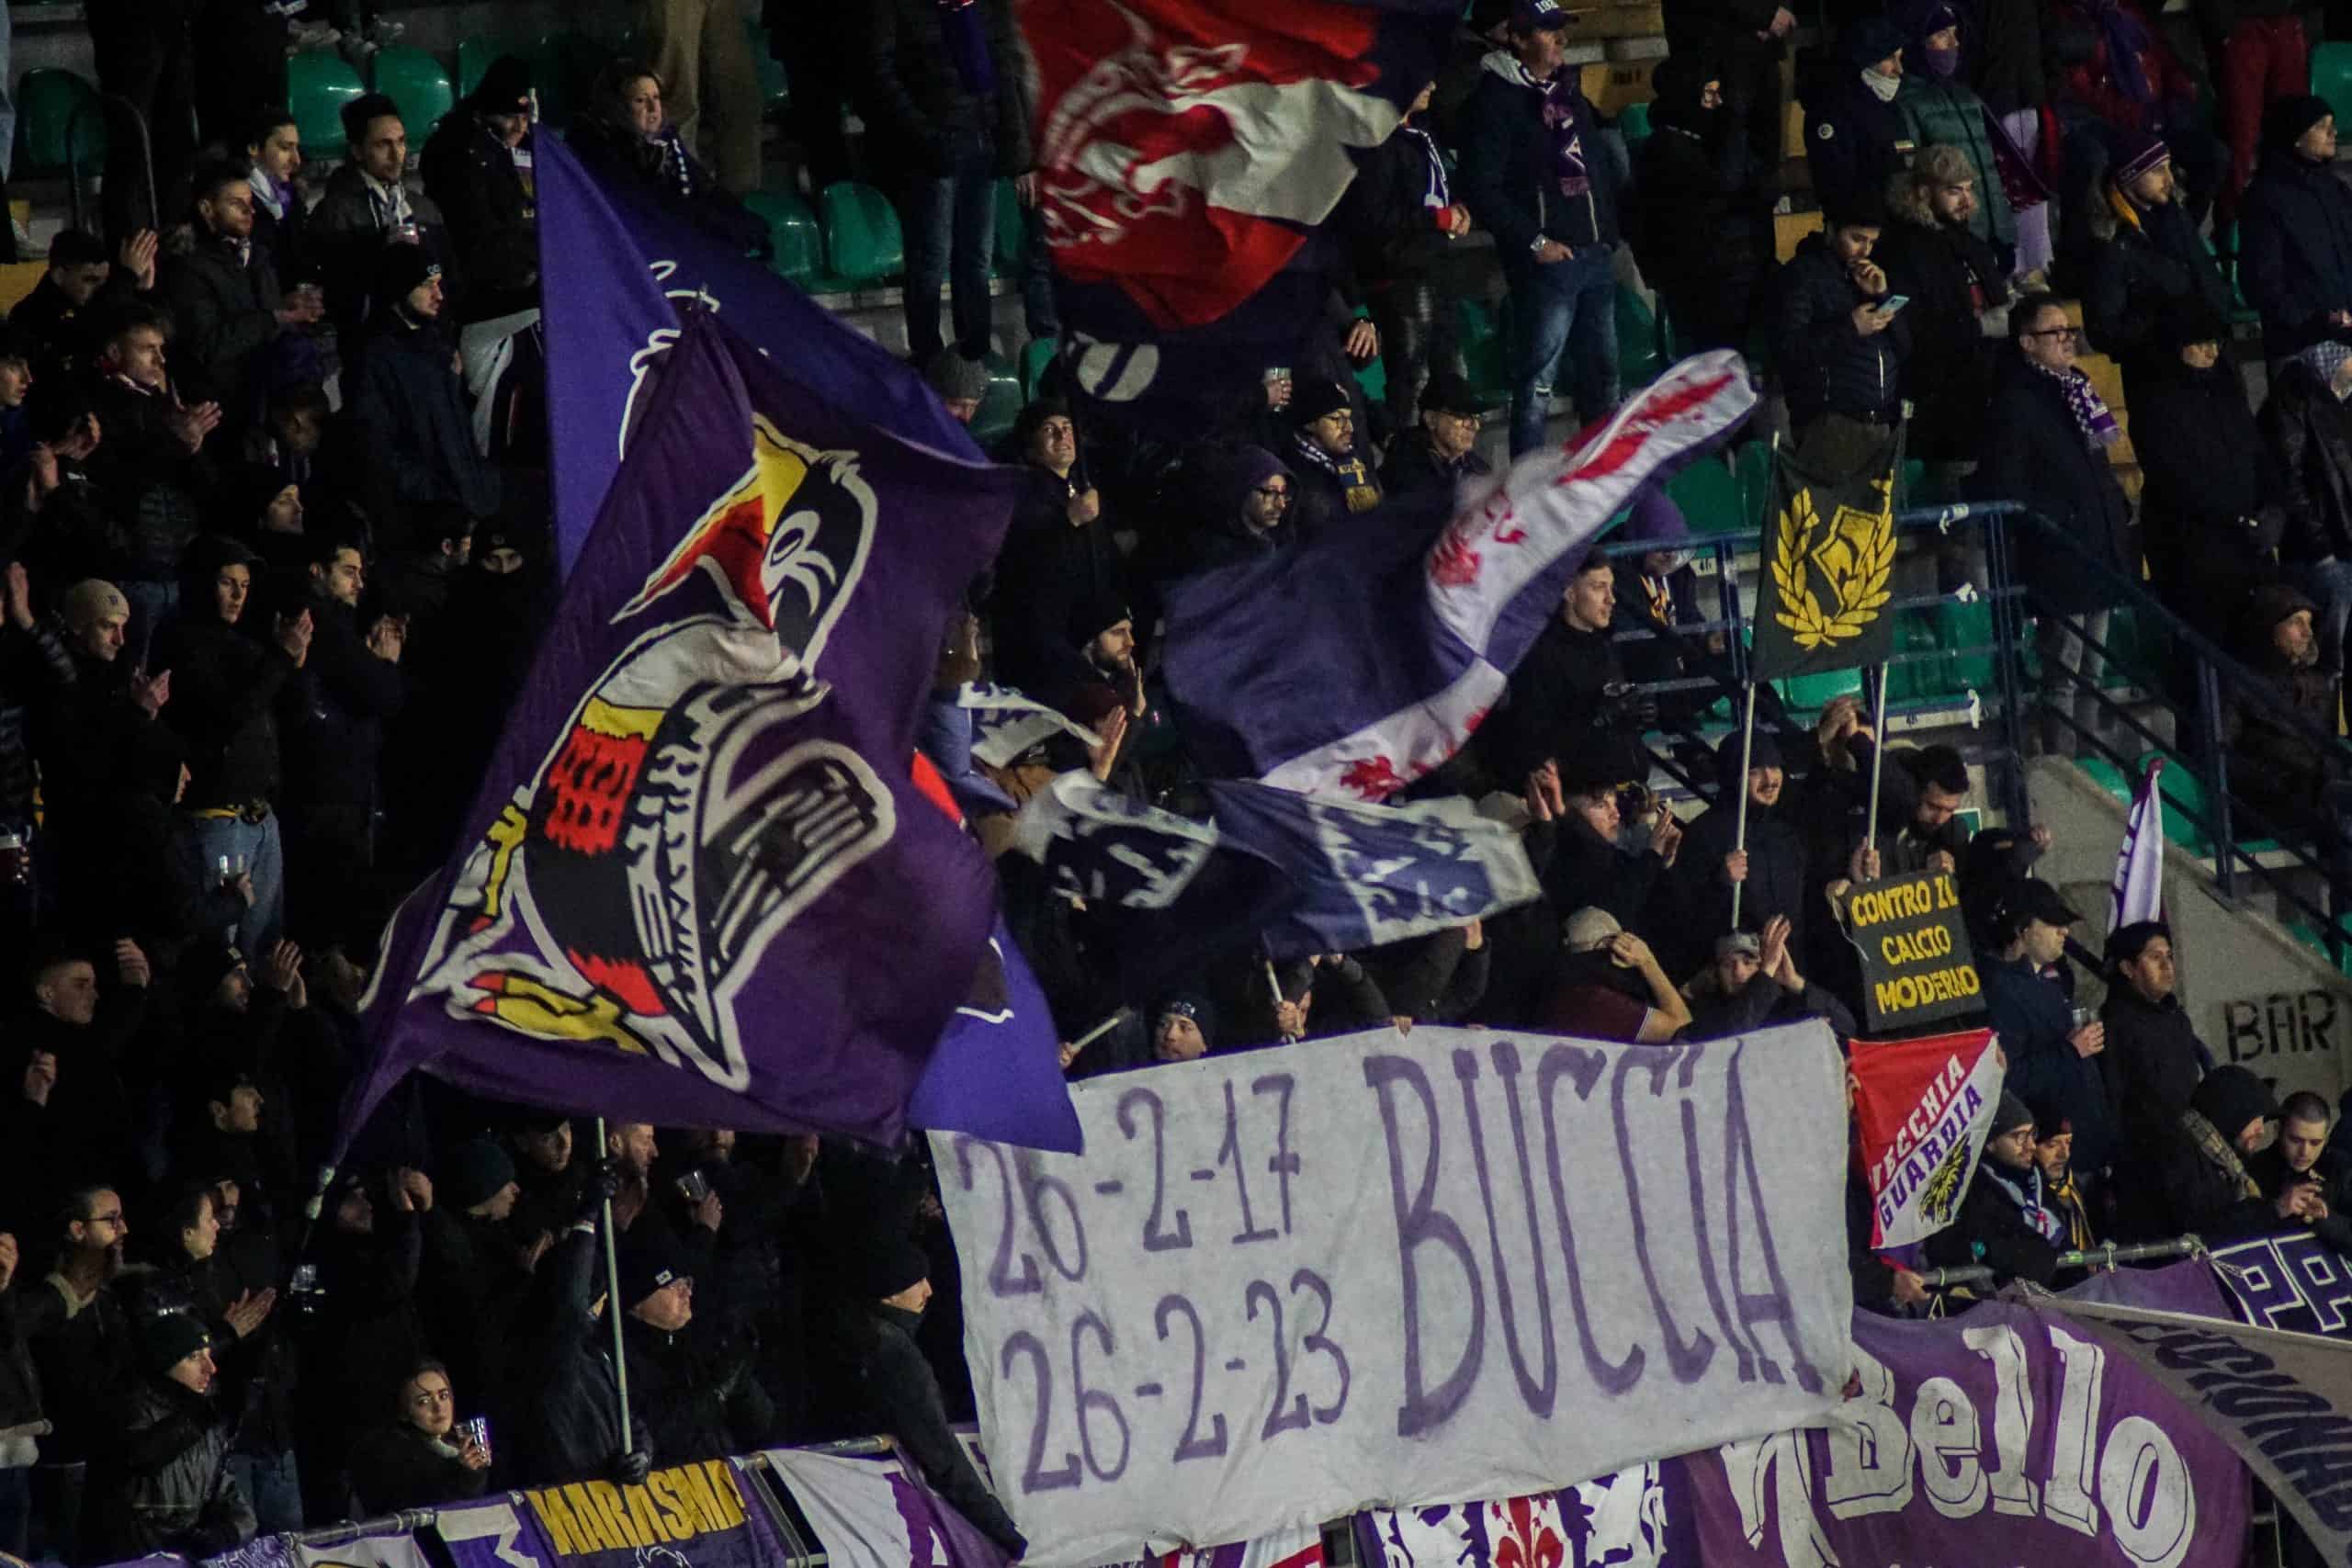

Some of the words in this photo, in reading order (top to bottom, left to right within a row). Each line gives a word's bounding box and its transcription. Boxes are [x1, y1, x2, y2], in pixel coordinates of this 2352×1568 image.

[1852, 881, 1932, 927] CONTRO
[1934, 874, 1959, 908] IL
[1882, 925, 1951, 965] CALCIO
[1875, 965, 1981, 1014] MODERNO
[2224, 990, 2335, 1062] BAR
[954, 1073, 1300, 1296] 26-2-17
[1879, 1085, 1983, 1229] GUARDIA
[1001, 1269, 1350, 1494] 26-2-23
